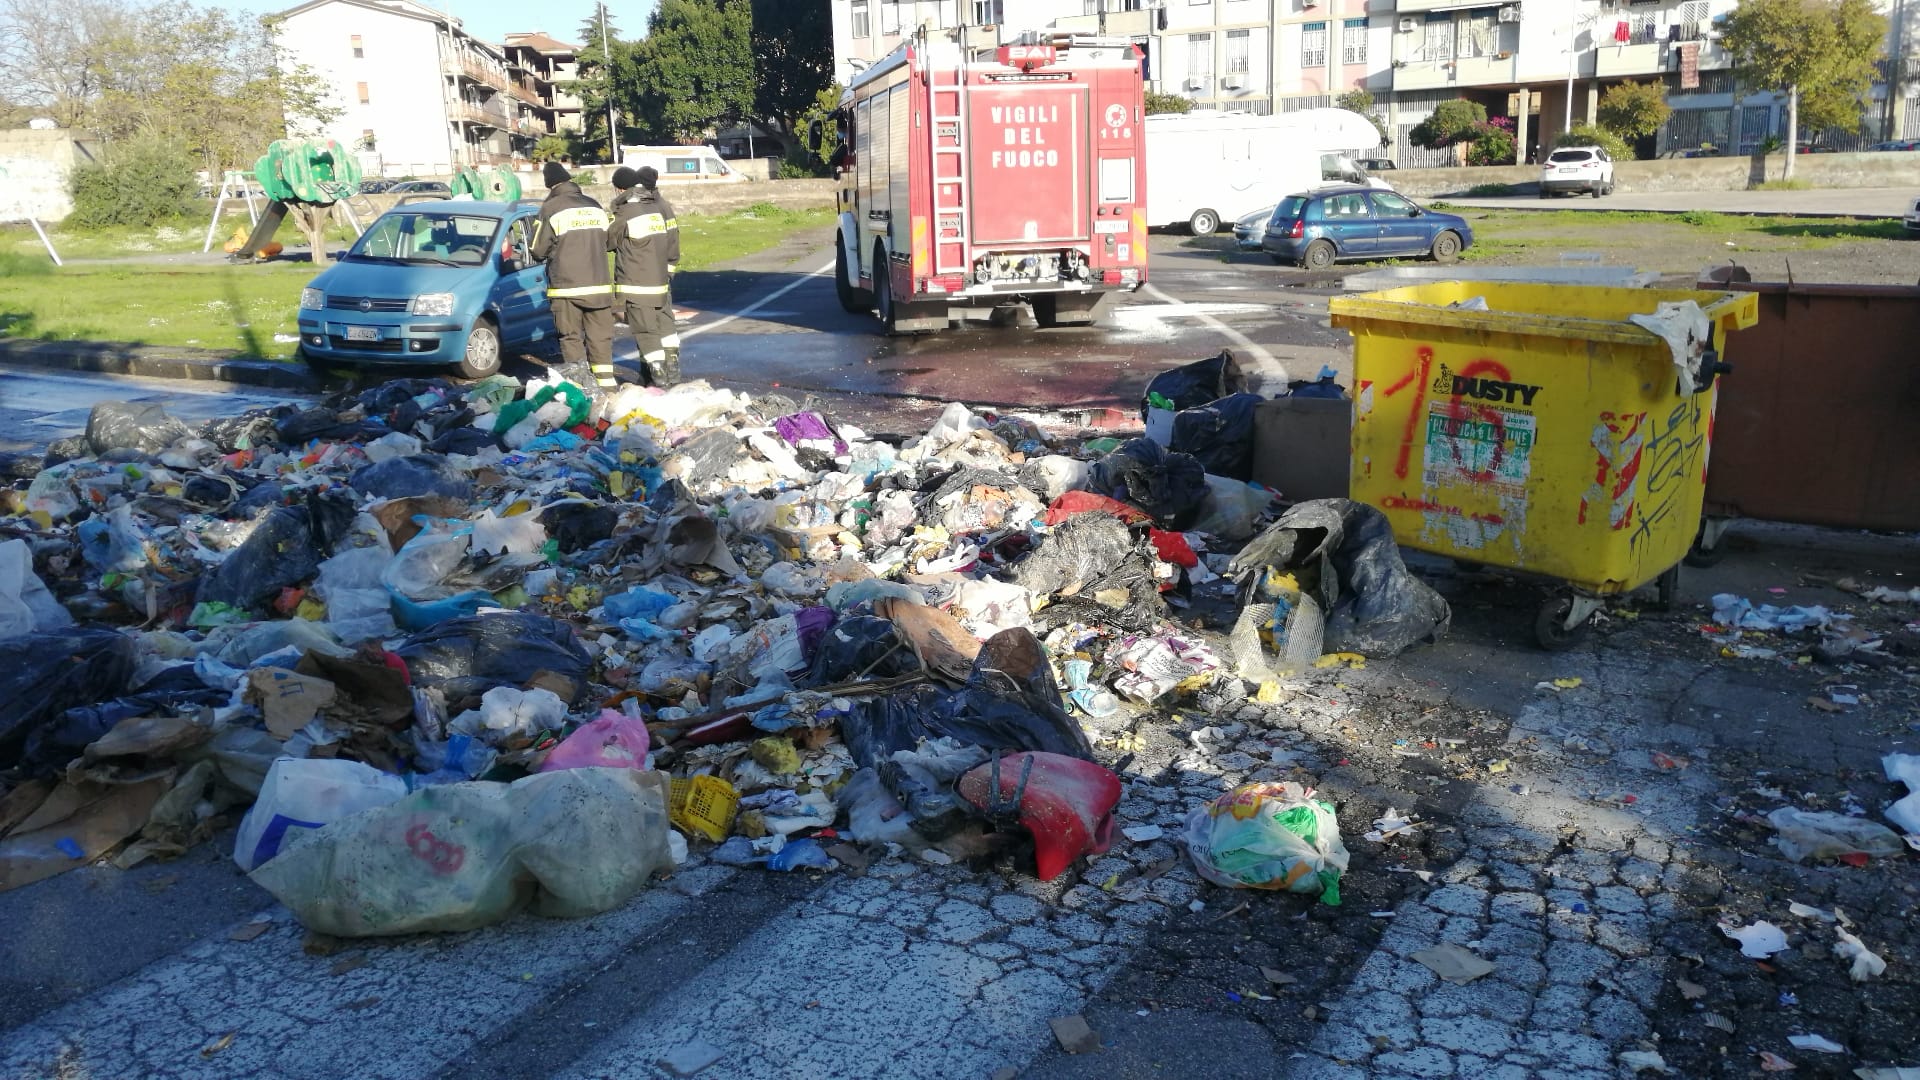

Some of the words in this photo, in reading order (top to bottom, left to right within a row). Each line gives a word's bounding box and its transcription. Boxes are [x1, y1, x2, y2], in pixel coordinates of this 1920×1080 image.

[1008, 47, 1052, 58] BAI
[991, 105, 1057, 124] VIGILI
[1004, 127, 1046, 145] DEL
[1100, 127, 1132, 139] 115
[991, 149, 1058, 168] FUOCO
[1452, 375, 1541, 406] DUSTY
